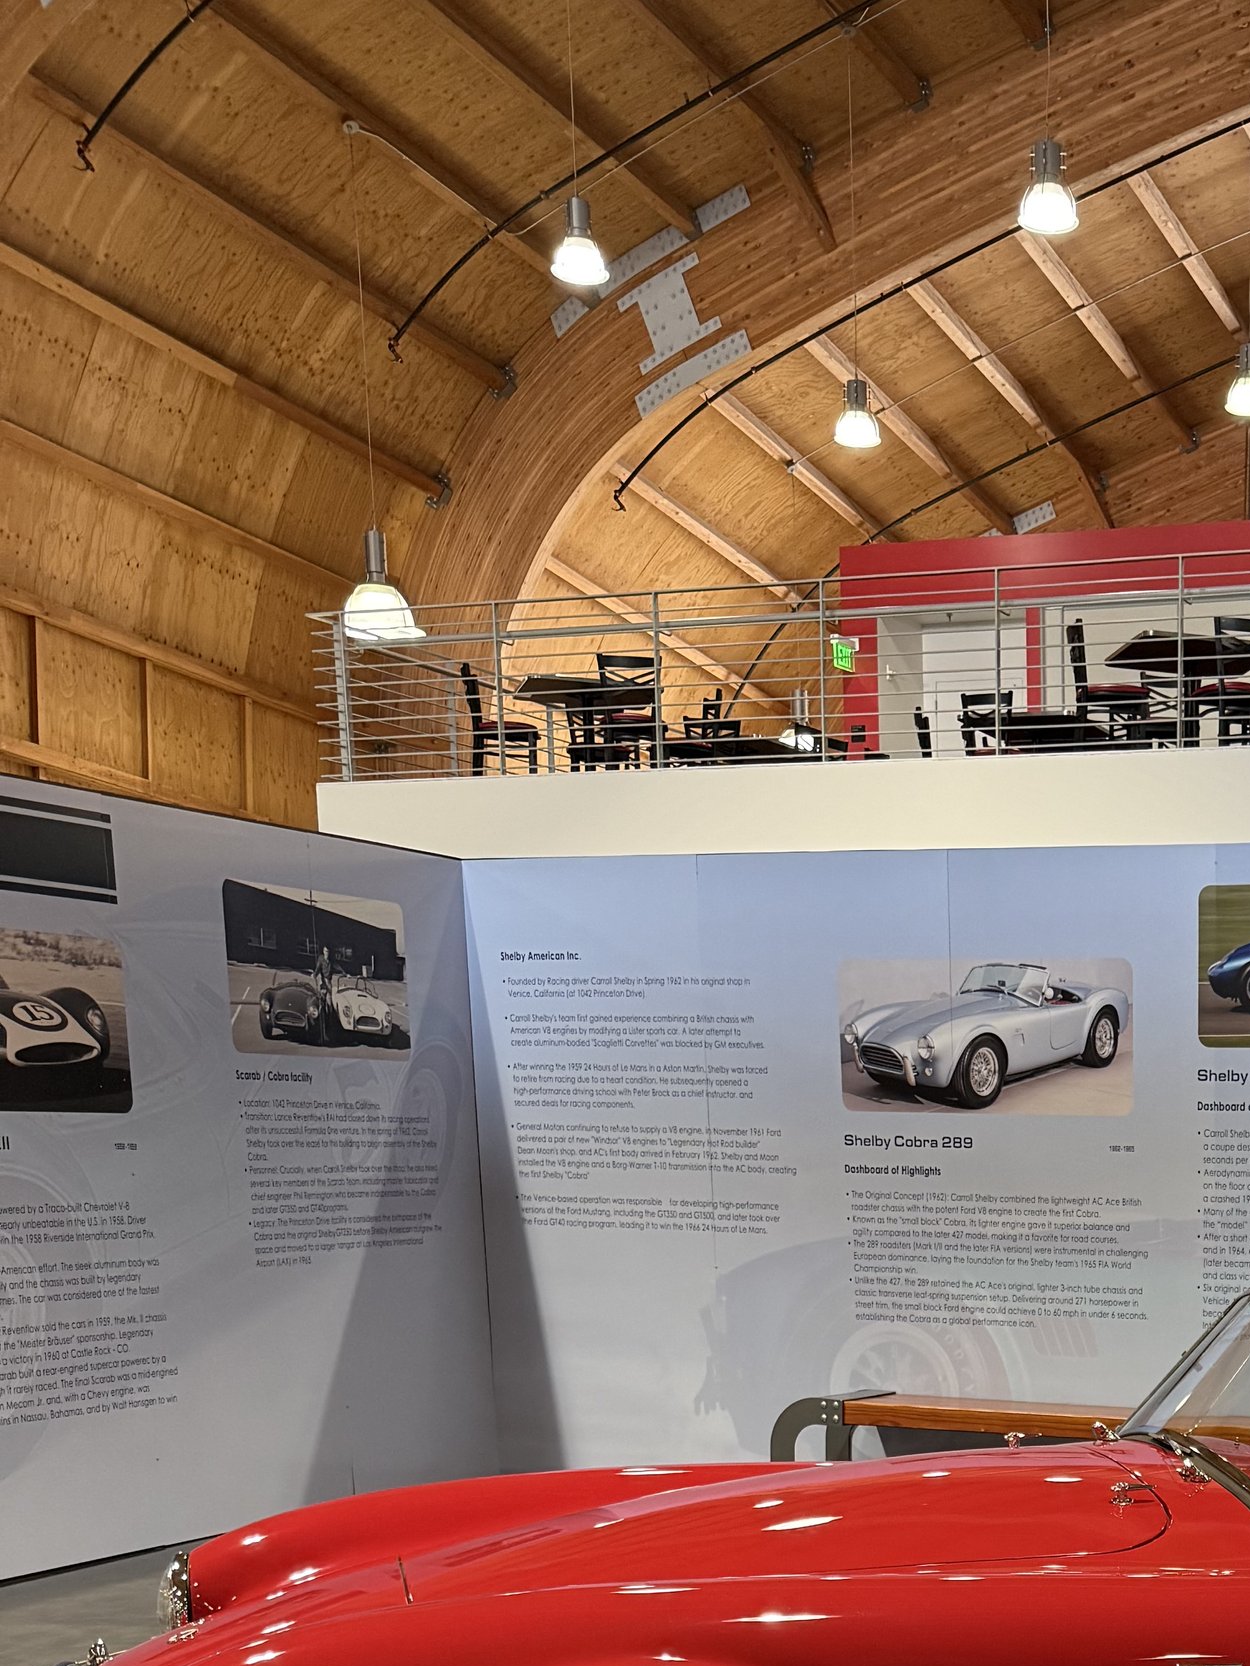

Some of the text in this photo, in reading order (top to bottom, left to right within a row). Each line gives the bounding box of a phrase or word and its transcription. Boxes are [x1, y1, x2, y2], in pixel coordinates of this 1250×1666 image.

[500, 950, 581, 962] Shelby American Inc.
[533, 988, 565, 997] California
[577, 988, 592, 997] 1042
[593, 988, 624, 997] Princeton
[625, 989, 645, 999] Drive)
[18, 1004, 54, 1021] 15
[235, 1069, 261, 1080] Scarab
[267, 1070, 289, 1081] Cobra
[290, 1071, 312, 1084] facility
[1197, 1069, 1248, 1085] Shelby
[1197, 1100, 1245, 1111] Dashboard
[1204, 1128, 1228, 1138] Carroll
[844, 1134, 972, 1150] Shelby Cobra 289
[1202, 1155, 1233, 1164] seconds
[1235, 1157, 1248, 1165] per
[844, 1164, 941, 1177] Dashboard of Highlights
[851, 1203, 879, 1211] roadster
[881, 1203, 904, 1212] chassis
[905, 1204, 920, 1212] with
[922, 1204, 934, 1213] the
[935, 1205, 958, 1214] potent
[960, 1205, 976, 1214] Ford
[977, 1206, 986, 1215] V8
[987, 1206, 1012, 1217] engine
[1014, 1208, 1022, 1216] to
[1023, 1208, 1047, 1216] create
[1048, 1208, 1060, 1217] the
[1062, 1208, 1074, 1217] first
[11, 1234, 23, 1244] the
[25, 1233, 42, 1243] 1958
[43, 1232, 74, 1242] Riverside
[75, 1230, 119, 1241] International
[120, 1229, 141, 1239] Grand
